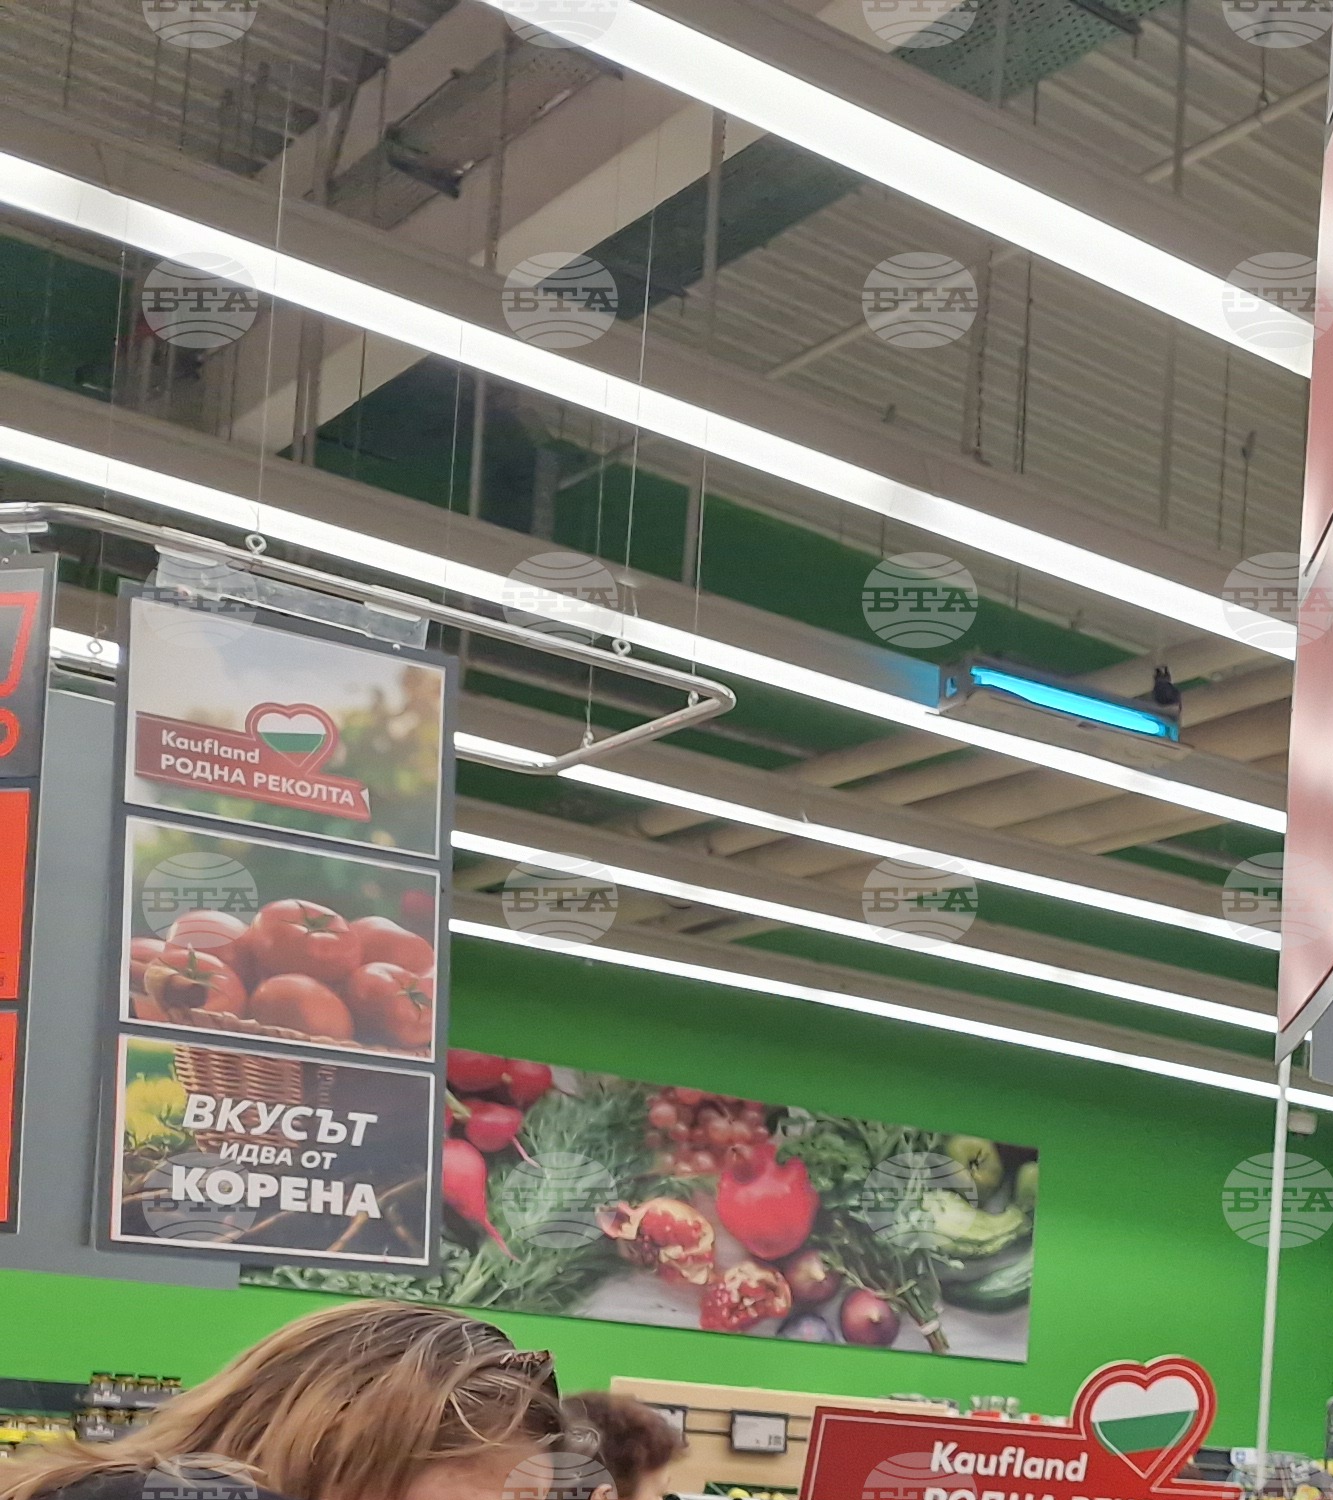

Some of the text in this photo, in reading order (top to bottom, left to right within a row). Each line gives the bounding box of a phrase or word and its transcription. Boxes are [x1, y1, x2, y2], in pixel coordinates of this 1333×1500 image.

[161, 729, 260, 765] Kaufland
[160, 753, 356, 807] РОДНА РЕКОЛТА
[182, 1093, 379, 1147] ВКУСЪТ
[219, 1141, 338, 1170] ИДВА ОТ
[171, 1165, 382, 1219] КОРЕНА
[929, 1440, 1089, 1483] Kaufland
